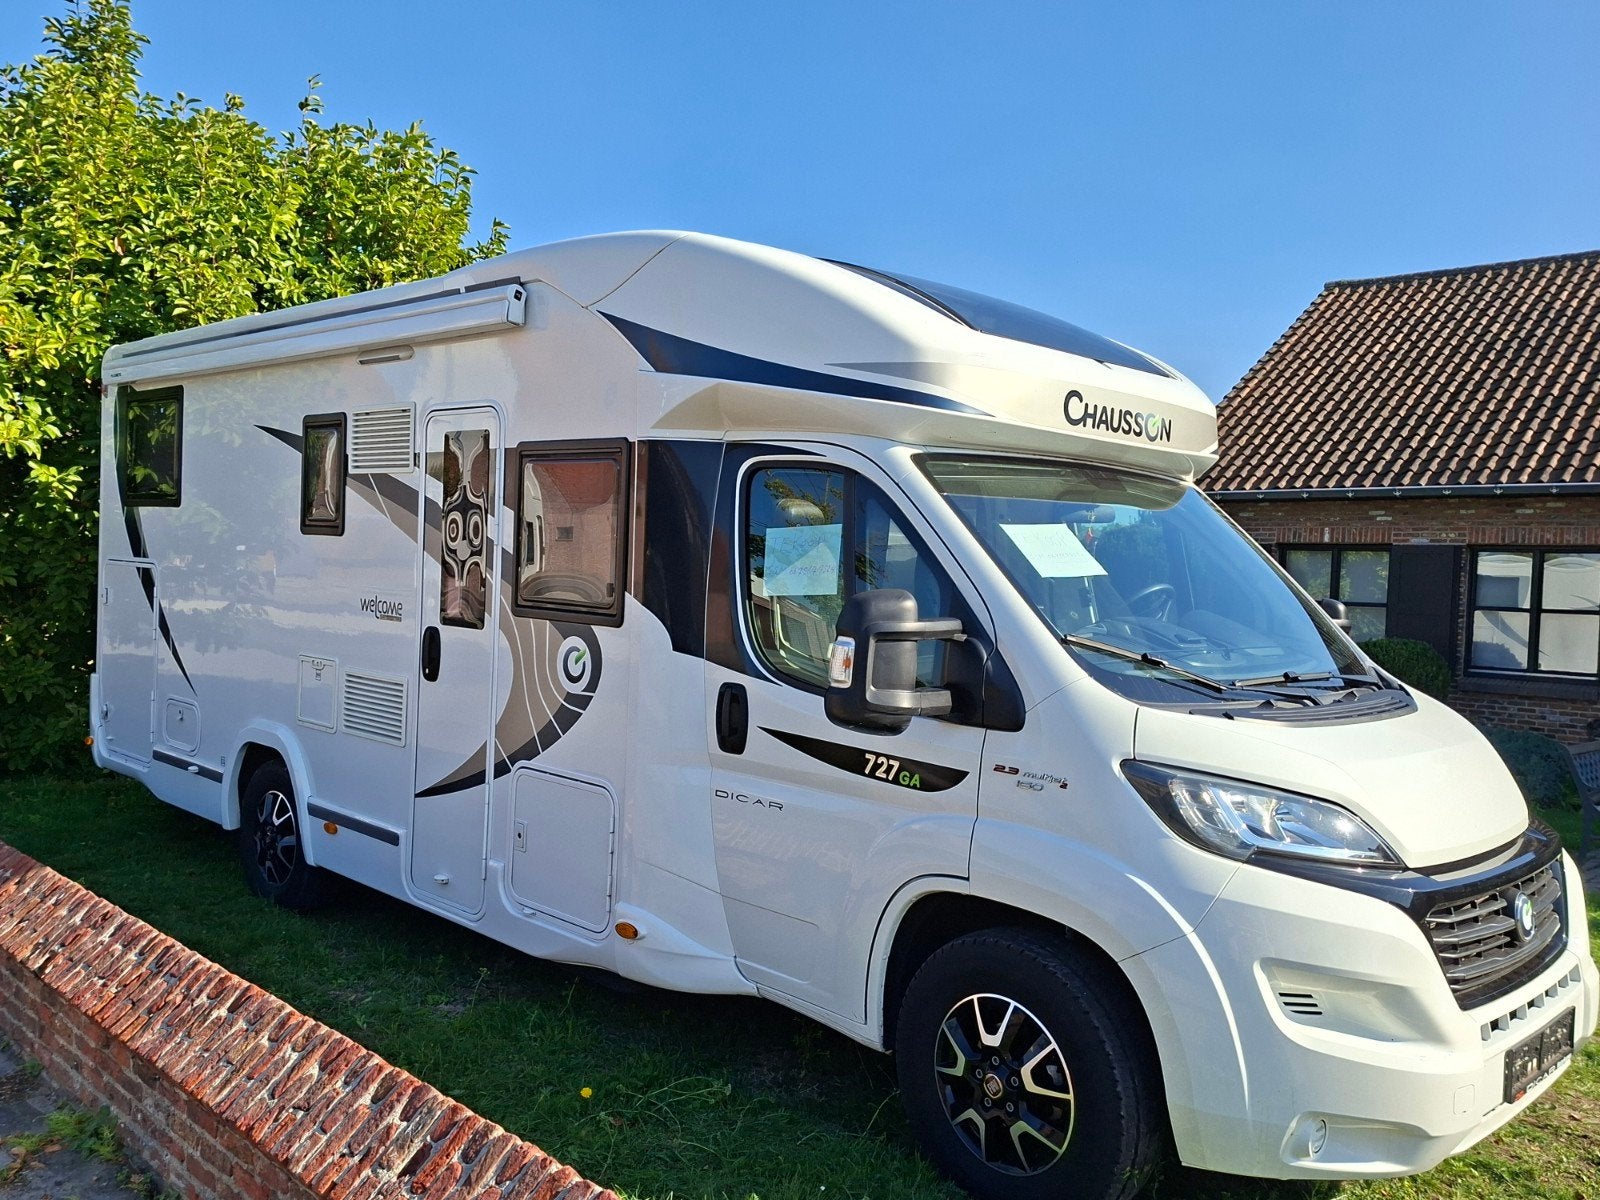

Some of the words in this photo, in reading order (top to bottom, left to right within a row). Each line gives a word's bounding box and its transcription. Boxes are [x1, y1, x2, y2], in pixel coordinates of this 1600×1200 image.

[1063, 389, 1172, 442] CHAUSSON
[360, 595, 403, 619] welcome
[864, 753, 900, 781] 727
[899, 771, 920, 788] GA
[715, 789, 784, 811] DICAR
